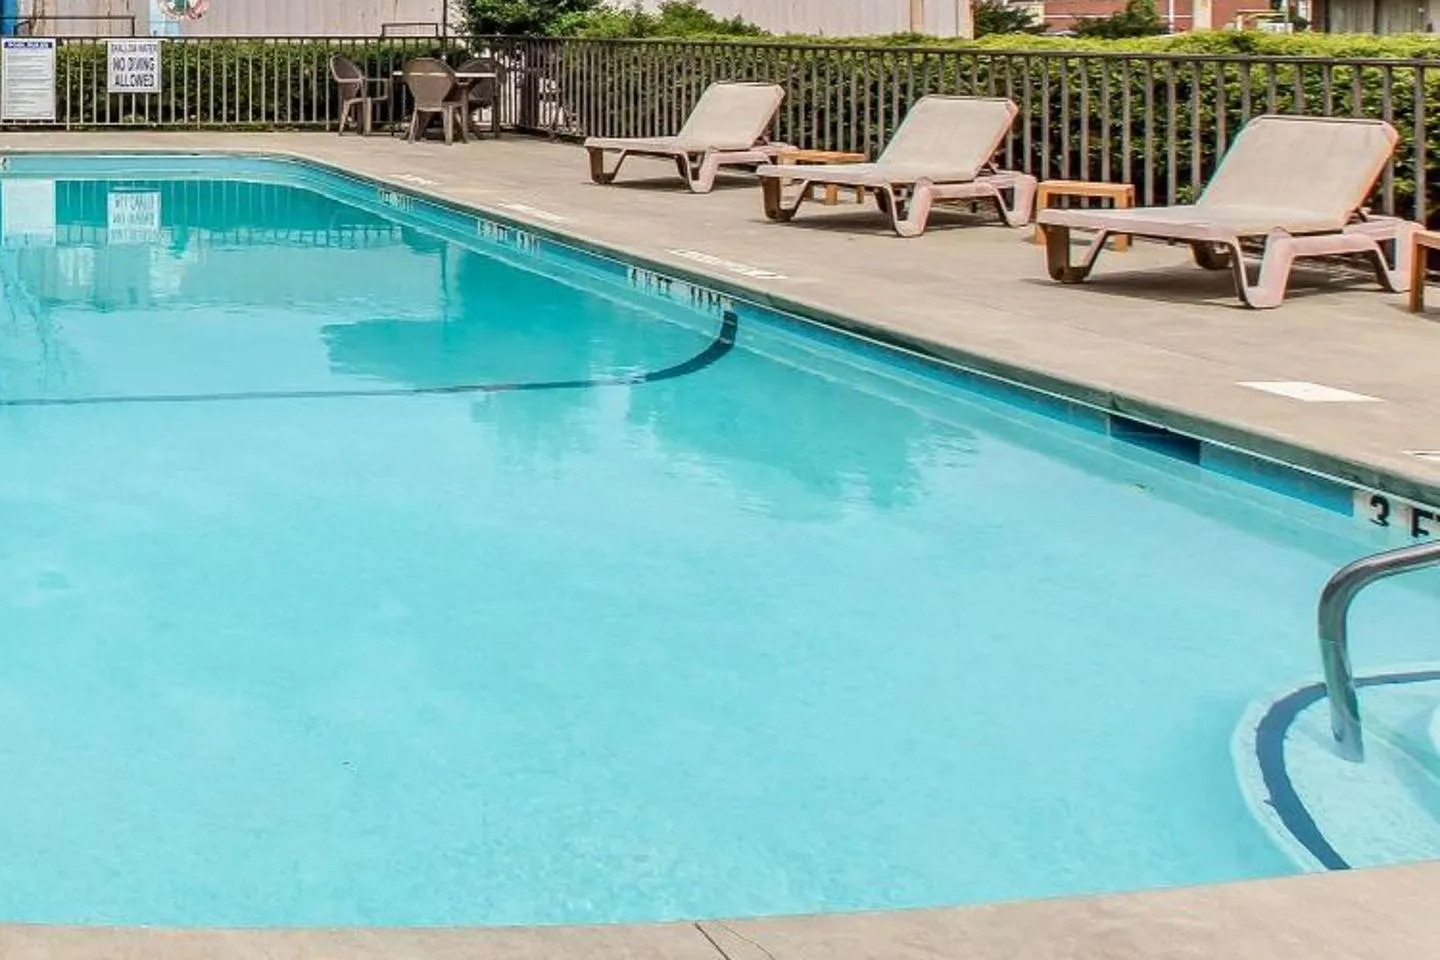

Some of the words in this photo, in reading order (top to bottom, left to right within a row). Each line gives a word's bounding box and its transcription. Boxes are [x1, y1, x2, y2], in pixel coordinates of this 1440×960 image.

[112, 57, 126, 71] NO
[128, 57, 154, 71] DIVING
[115, 74, 154, 87] ALLOWED
[1411, 507, 1440, 538] F
